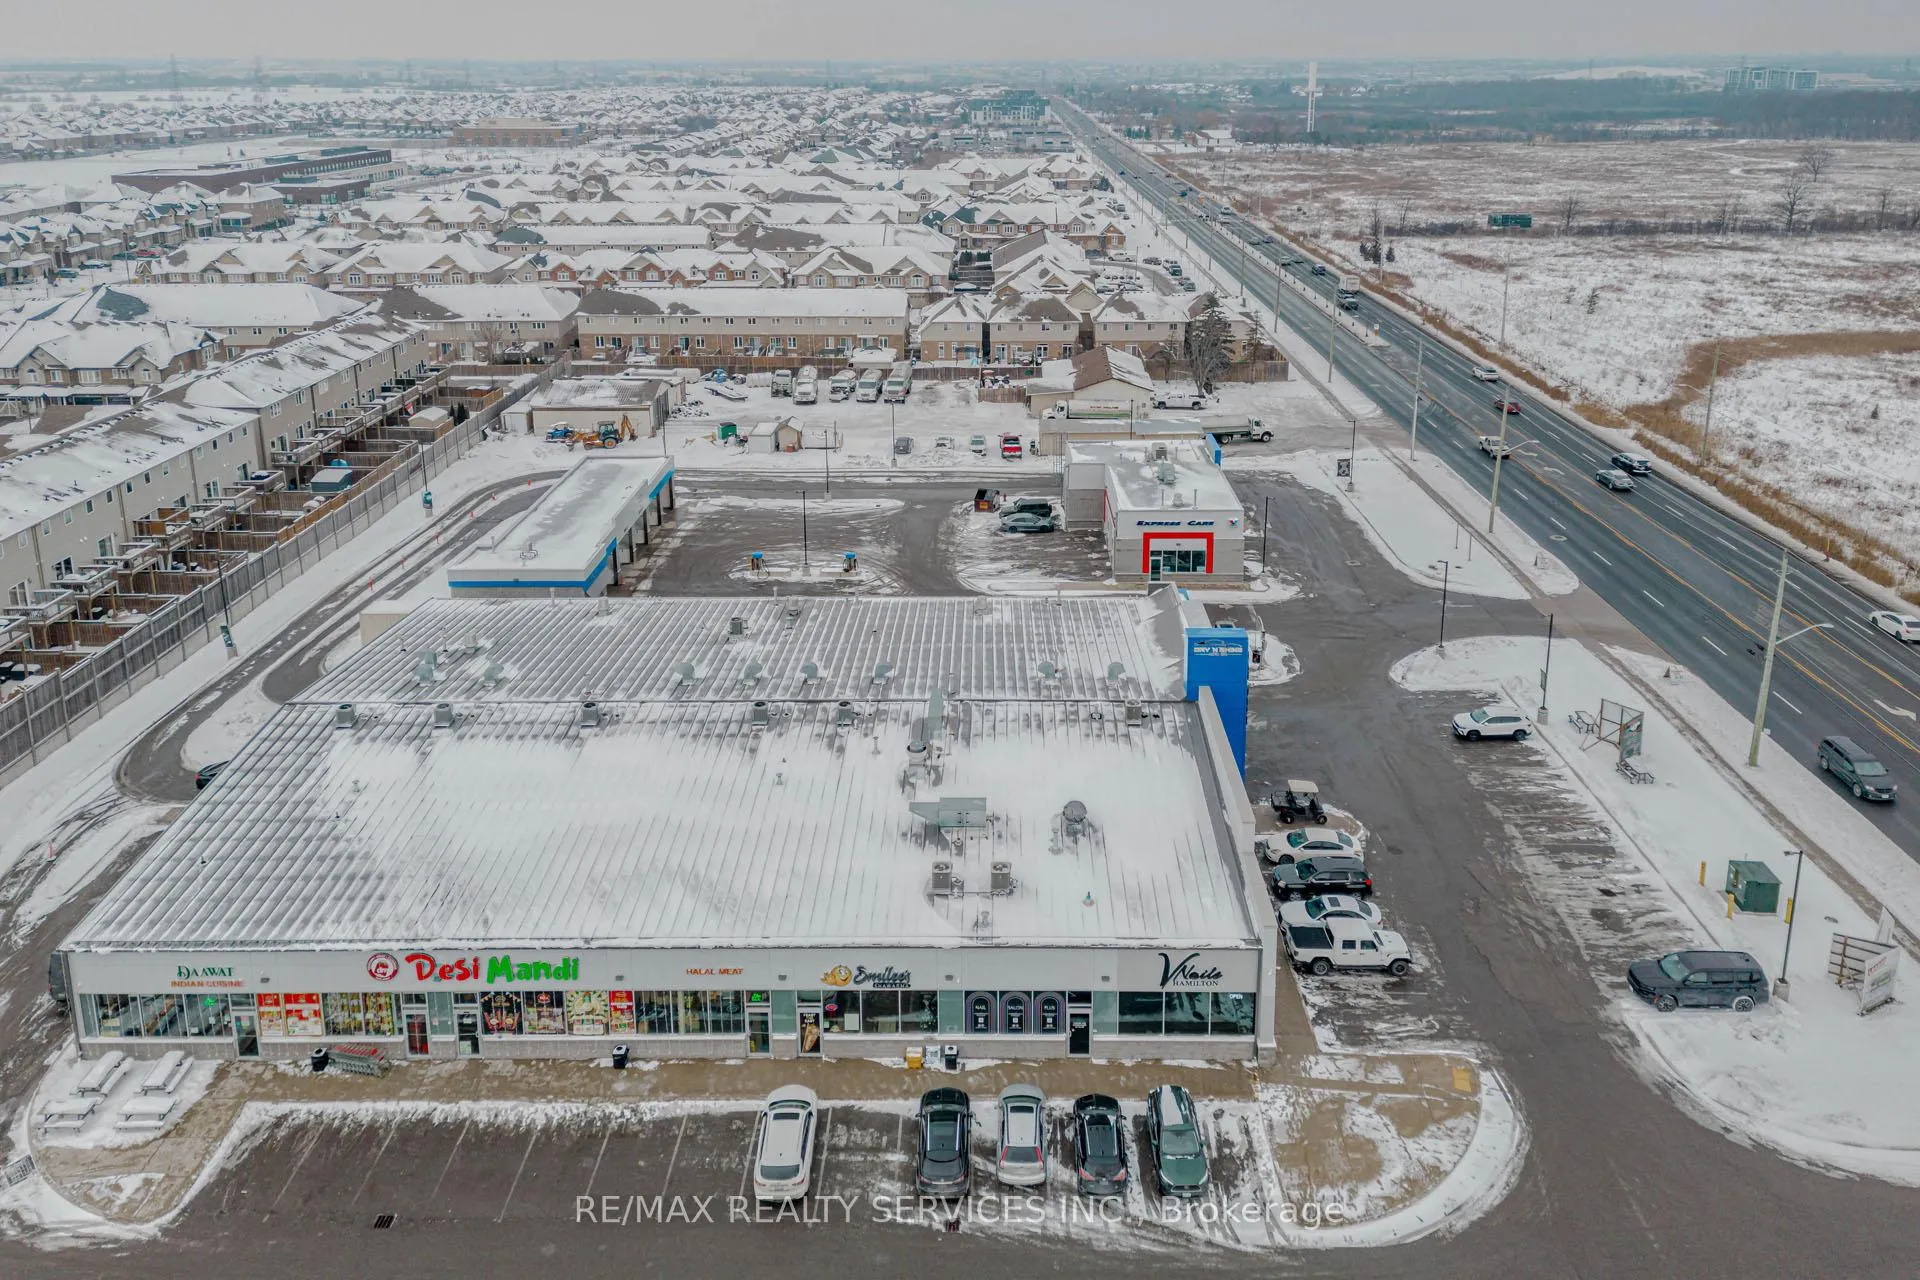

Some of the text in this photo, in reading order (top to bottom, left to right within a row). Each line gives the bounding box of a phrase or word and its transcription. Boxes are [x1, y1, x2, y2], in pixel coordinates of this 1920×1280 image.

[404, 952, 579, 984] Desi Mandi
[171, 980, 242, 988] INDIAN CUISINE
